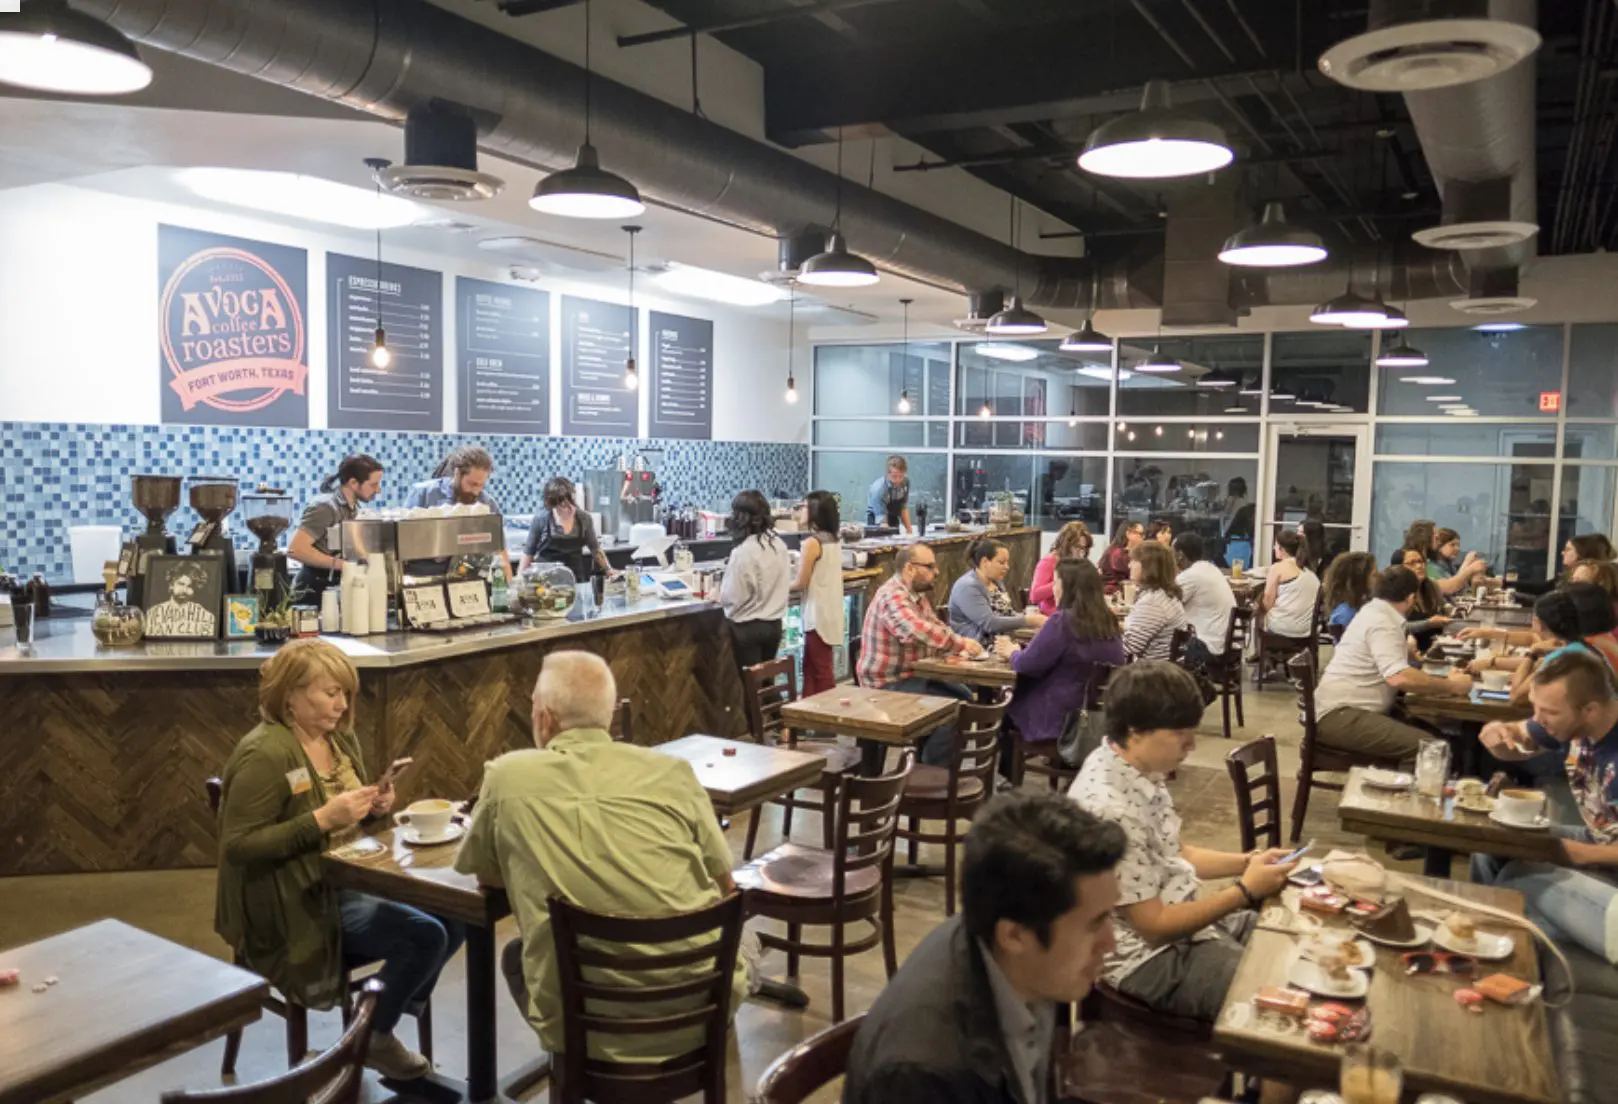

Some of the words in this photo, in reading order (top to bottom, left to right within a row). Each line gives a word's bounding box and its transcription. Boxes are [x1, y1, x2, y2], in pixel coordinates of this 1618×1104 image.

[180, 286, 287, 336] AVOCA
[212, 314, 257, 334] coffee
[181, 332, 291, 362] roasters
[187, 374, 216, 393] FORT
[260, 367, 294, 380] TEXAS
